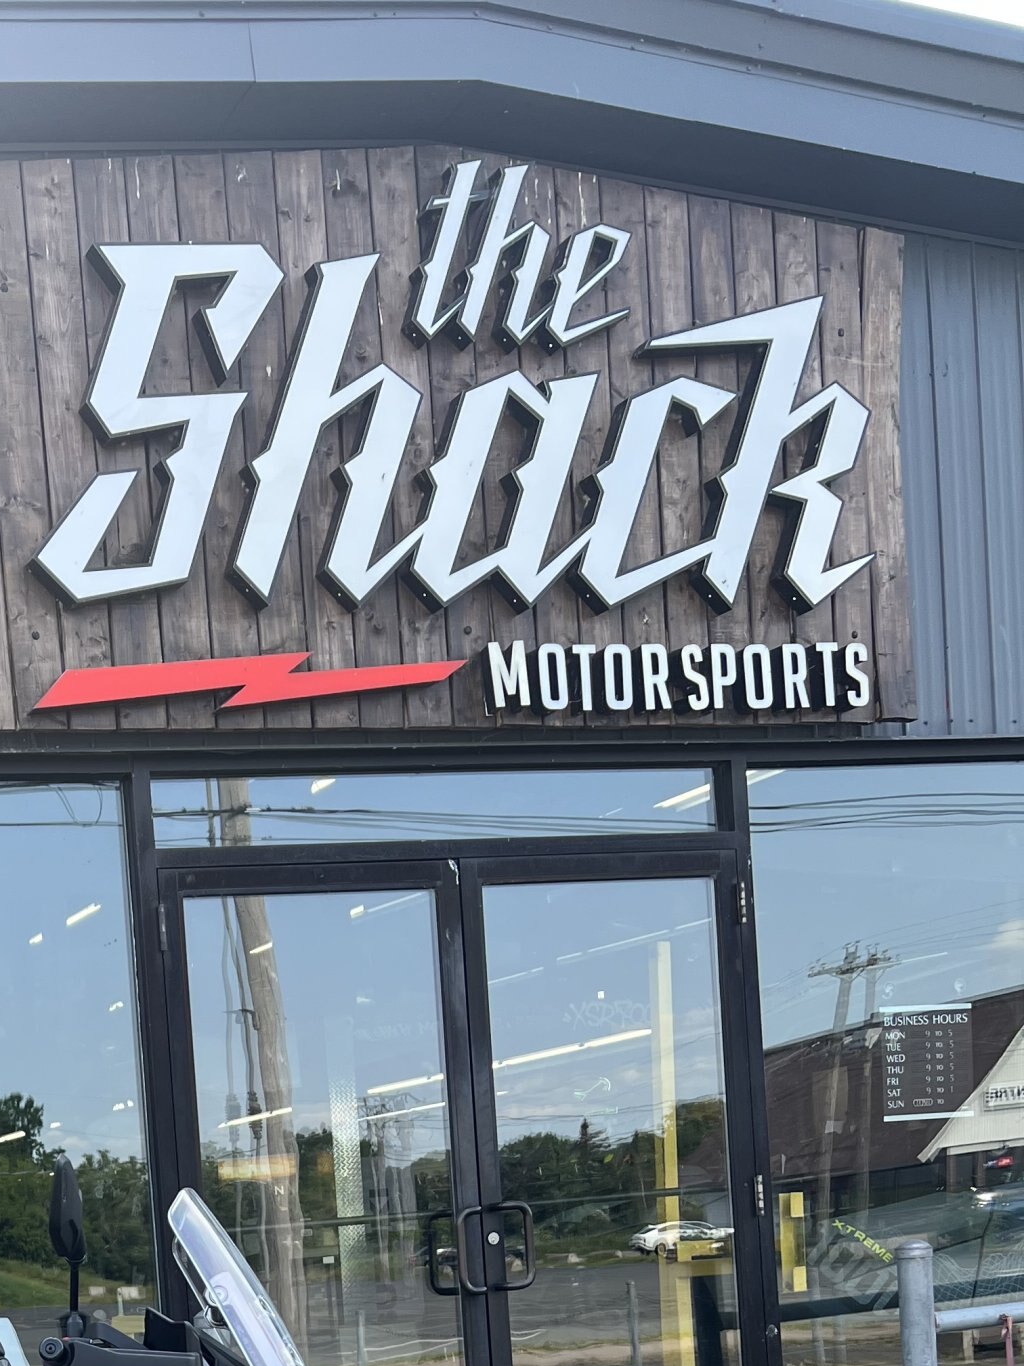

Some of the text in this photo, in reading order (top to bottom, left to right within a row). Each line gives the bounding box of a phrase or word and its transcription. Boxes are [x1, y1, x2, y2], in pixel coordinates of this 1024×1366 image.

[410, 159, 632, 345] the
[32, 242, 876, 608] Shack
[487, 641, 872, 713] MOTORSPORTS
[883, 1013, 969, 1027] BUSINESS HOURS
[885, 1031, 906, 1041] MON
[886, 1043, 902, 1052] TUE
[886, 1054, 906, 1063] WED
[886, 1066, 904, 1074] THU
[886, 1077, 899, 1086] FRI
[887, 1088, 902, 1097] SAT
[887, 1099, 905, 1109] SUN
[832, 1219, 894, 1263] XTREME
